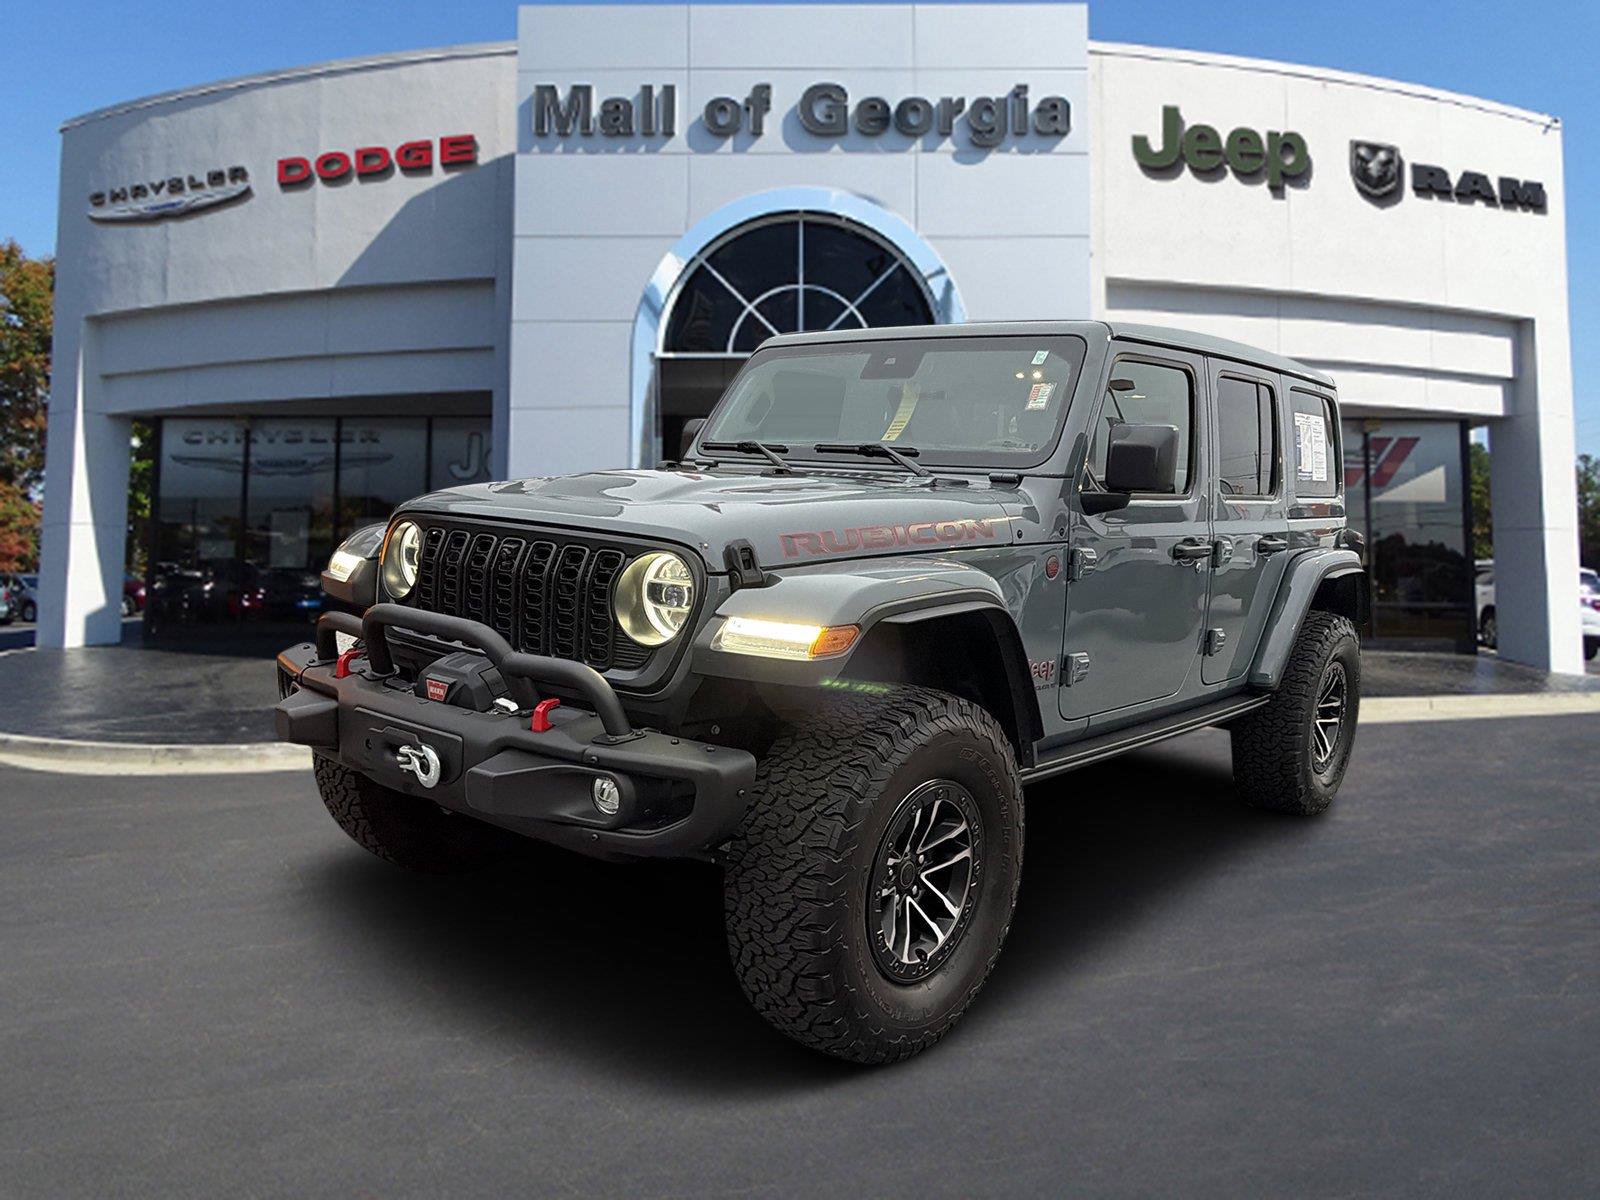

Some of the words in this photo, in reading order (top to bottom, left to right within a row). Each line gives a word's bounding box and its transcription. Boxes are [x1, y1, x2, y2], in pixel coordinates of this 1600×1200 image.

[533, 83, 677, 138] Mall
[704, 83, 773, 138] of
[799, 82, 1072, 148] Georgia
[277, 133, 477, 190] DODGE
[1131, 105, 1310, 196] Jeep
[89, 165, 249, 208] CHRYSLER
[1411, 162, 1547, 214] RAM
[778, 517, 997, 560] RUBICON
